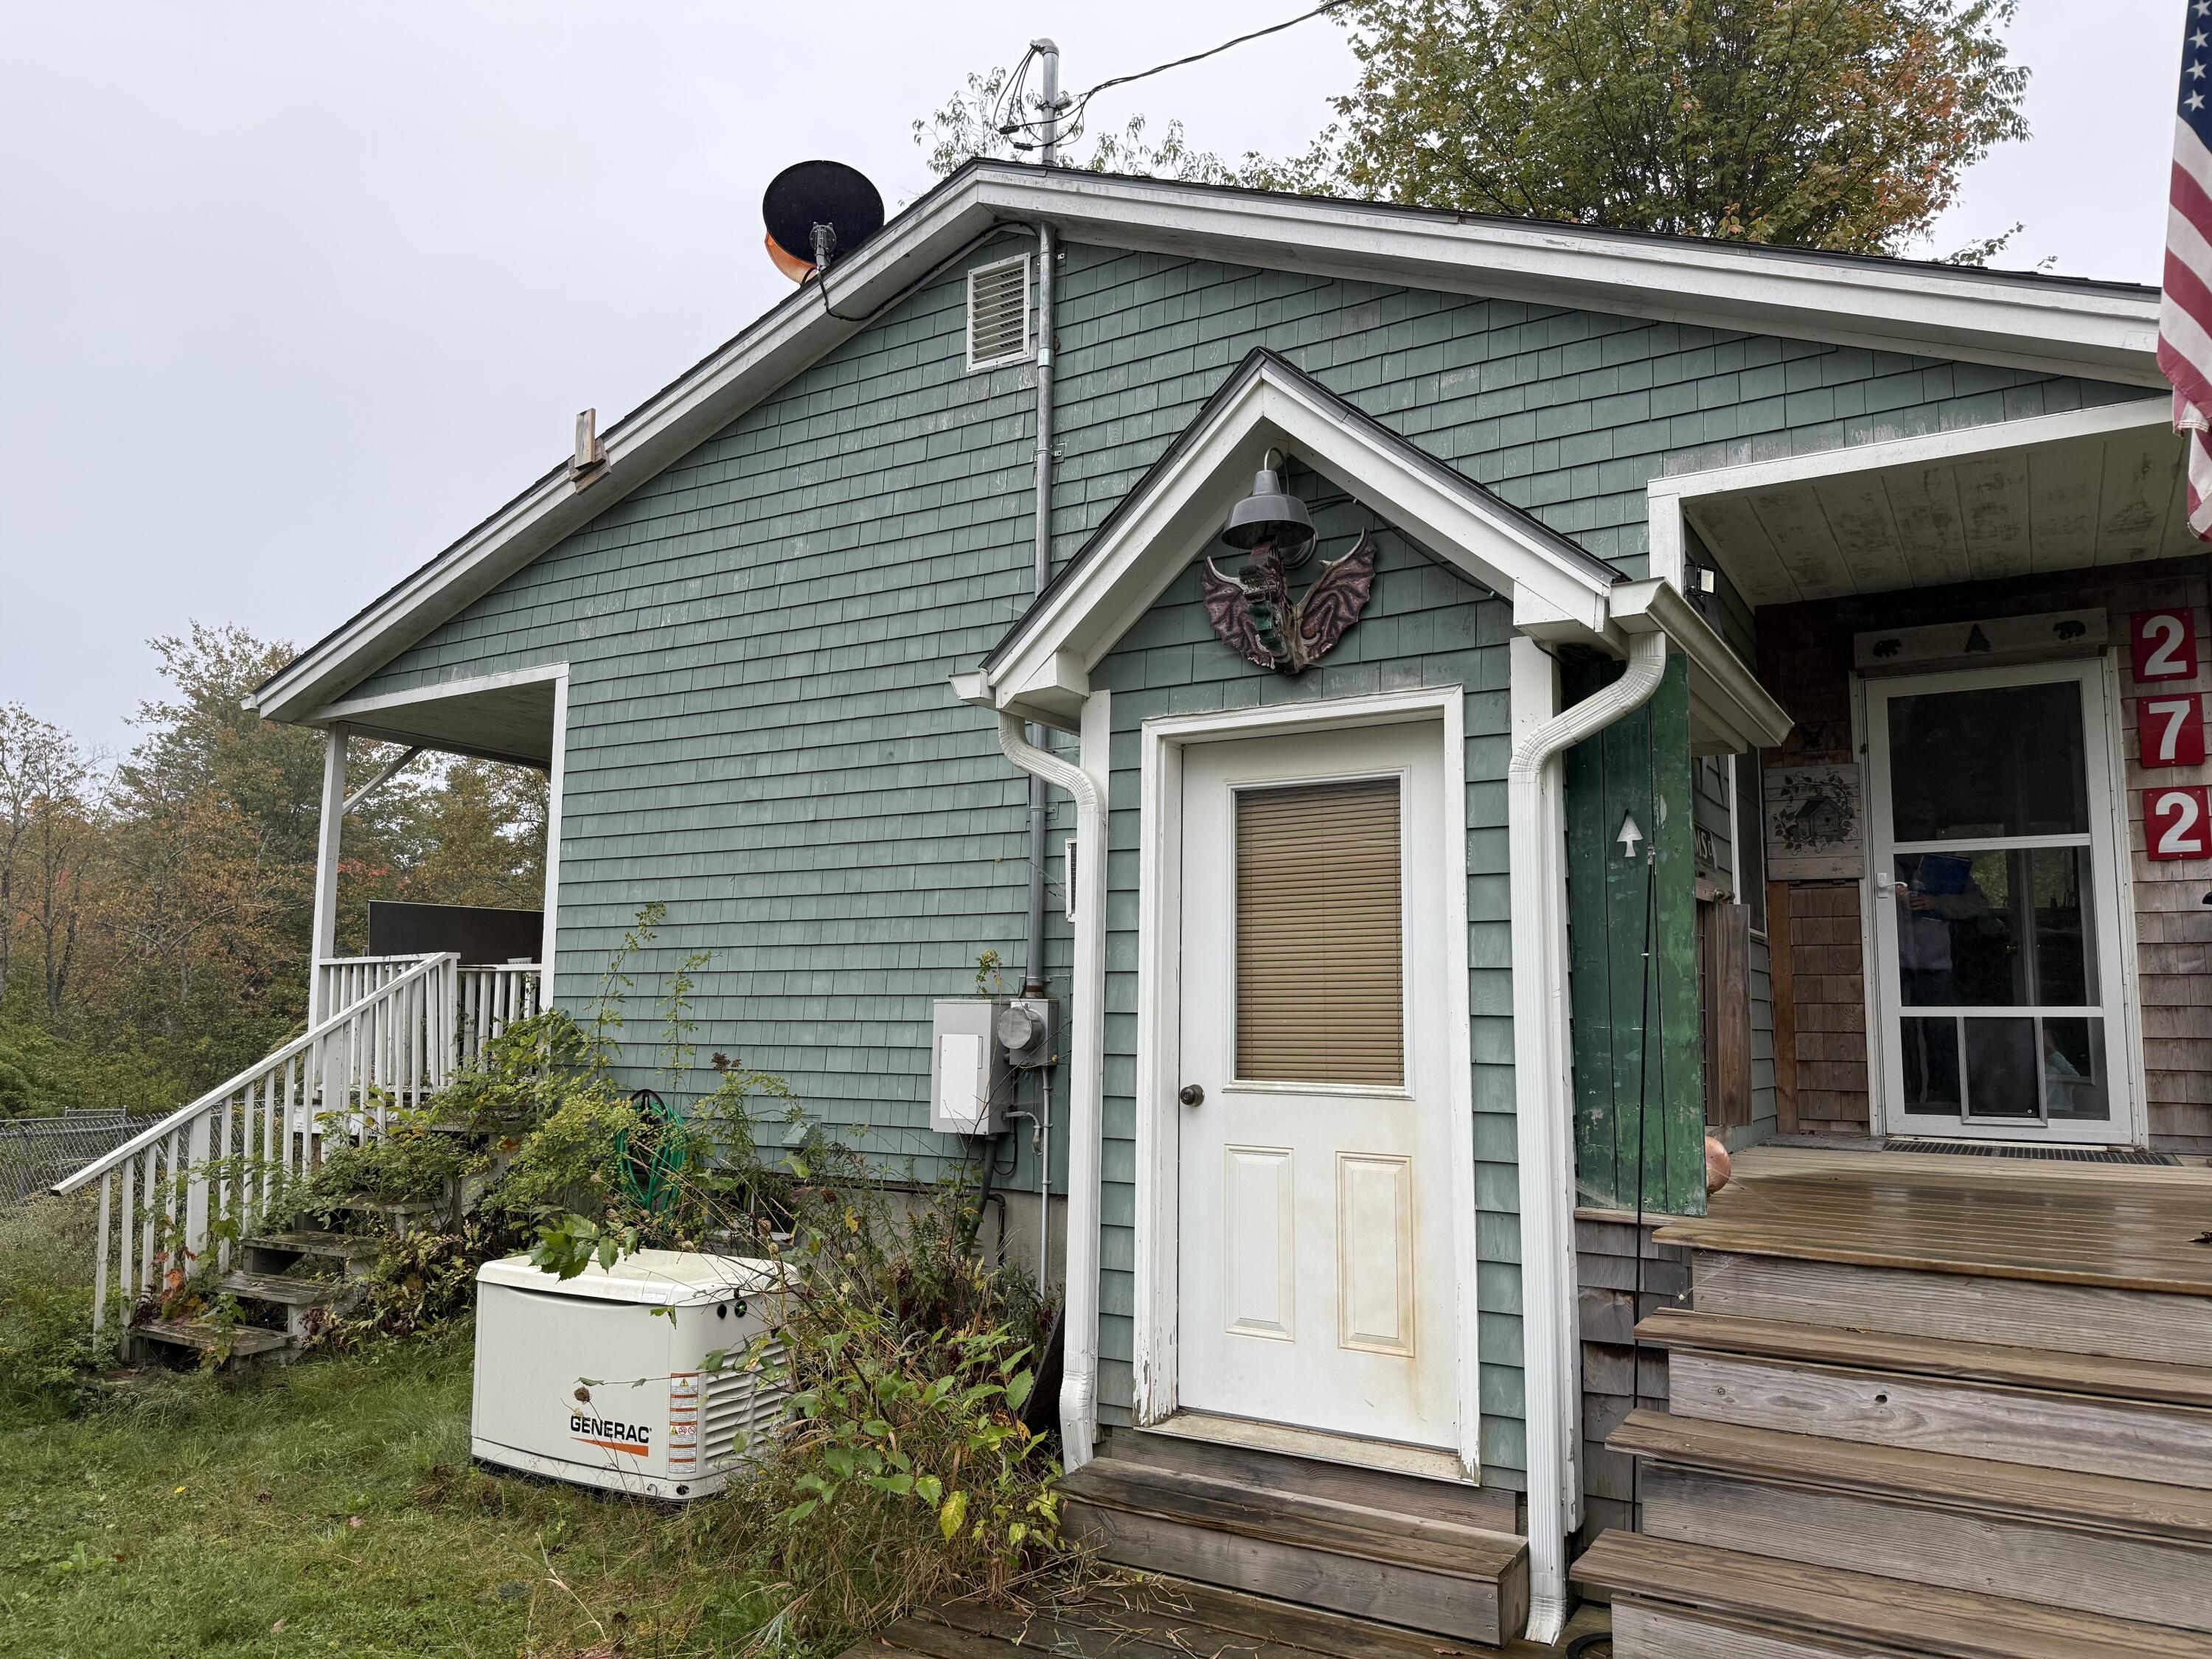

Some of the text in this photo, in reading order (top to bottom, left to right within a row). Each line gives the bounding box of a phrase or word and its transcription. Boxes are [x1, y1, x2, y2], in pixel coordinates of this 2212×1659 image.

[2142, 615, 2187, 676] 2
[2149, 700, 2191, 760] 7
[2155, 791, 2202, 854] 2
[571, 1415, 649, 1444] GENERAC
